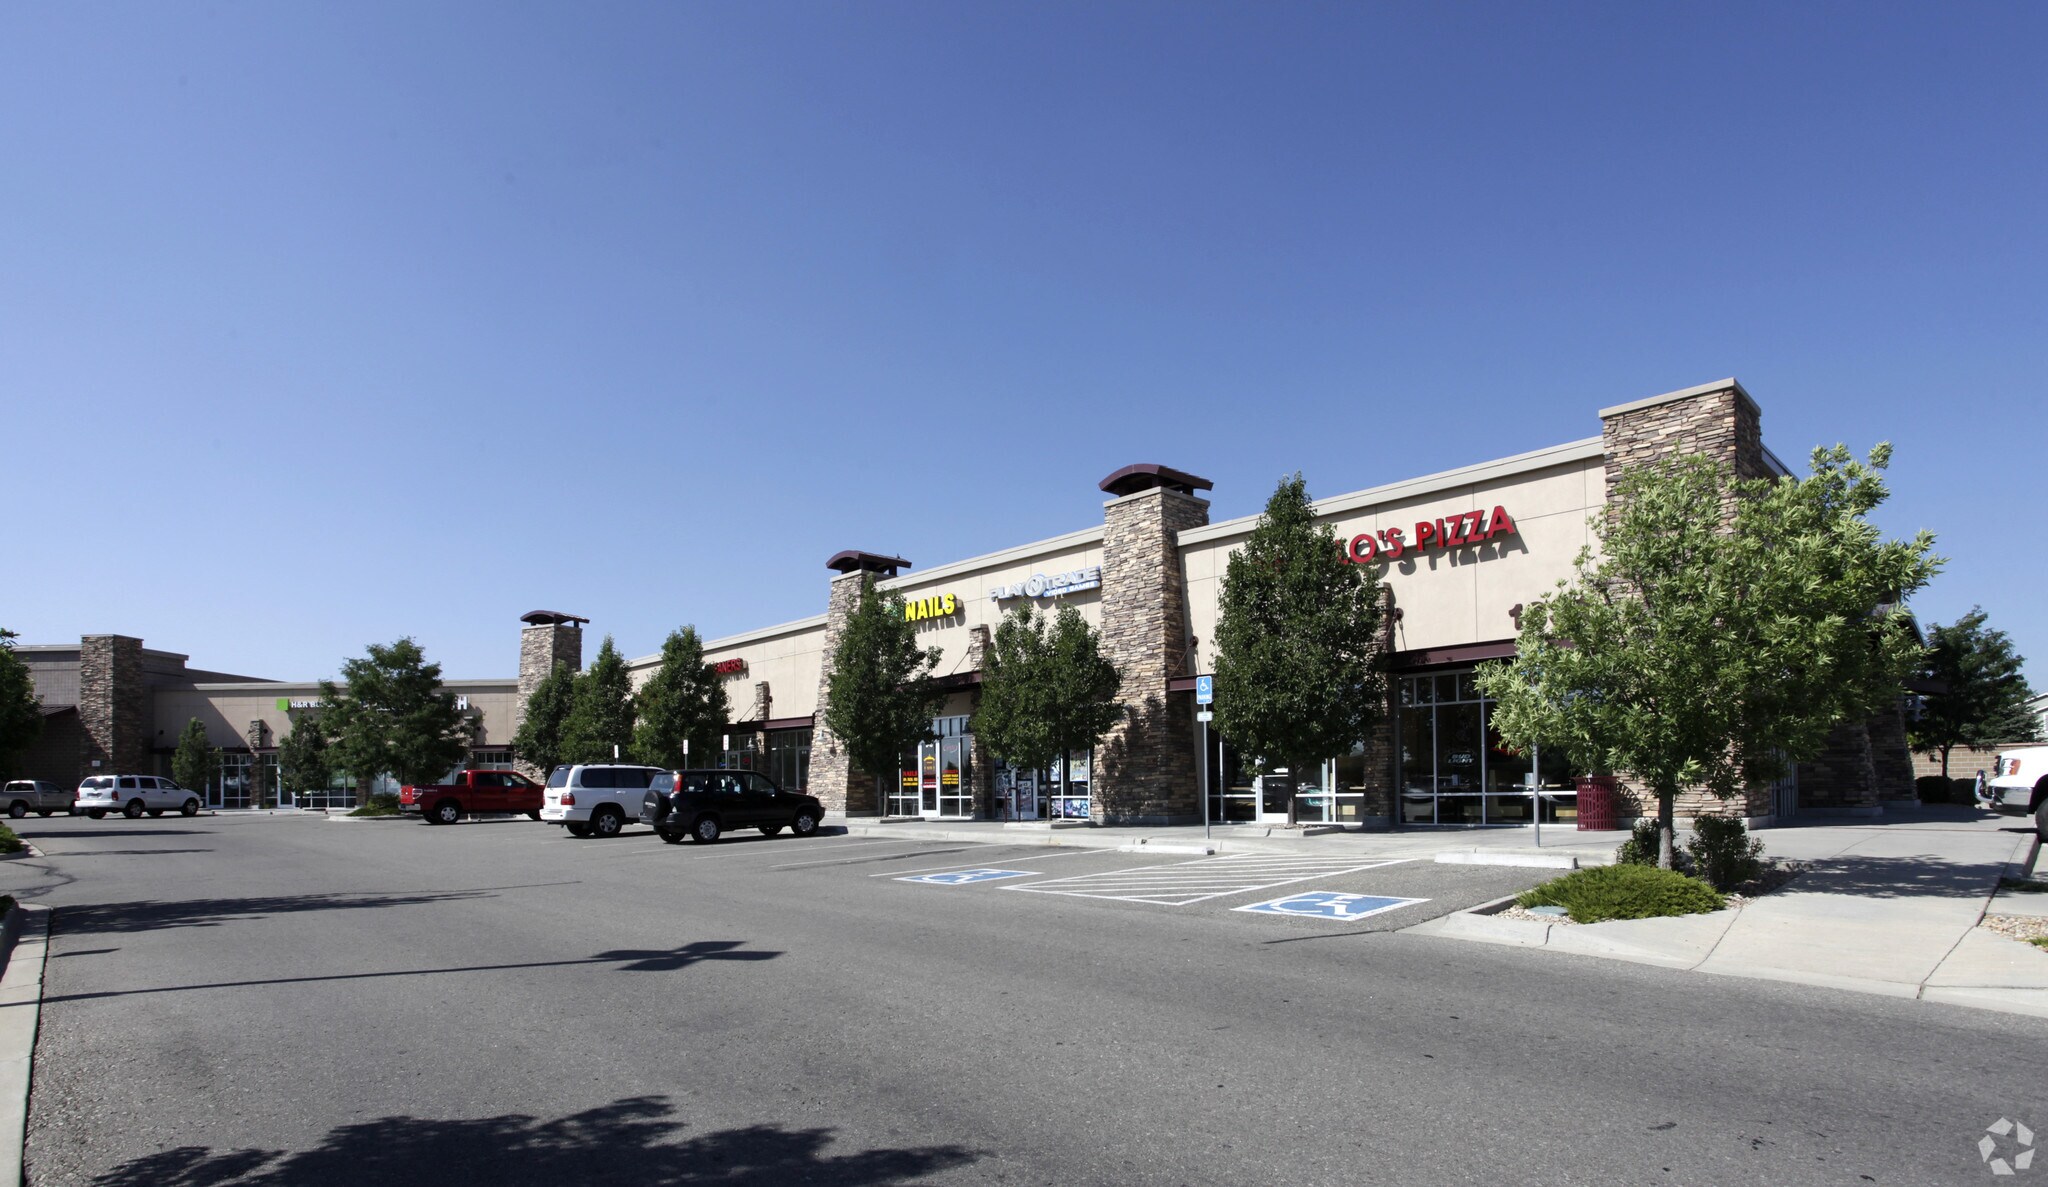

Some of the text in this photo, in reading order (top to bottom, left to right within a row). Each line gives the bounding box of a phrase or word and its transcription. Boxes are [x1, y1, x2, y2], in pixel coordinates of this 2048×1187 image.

[1415, 505, 1516, 553] PIZZA
[990, 581, 1025, 602] PLAY
[1045, 566, 1101, 590] TRADE
[1046, 581, 1096, 597] VIDEO GAMES
[905, 593, 955, 622] NAILS
[714, 658, 743, 673] ANERS
